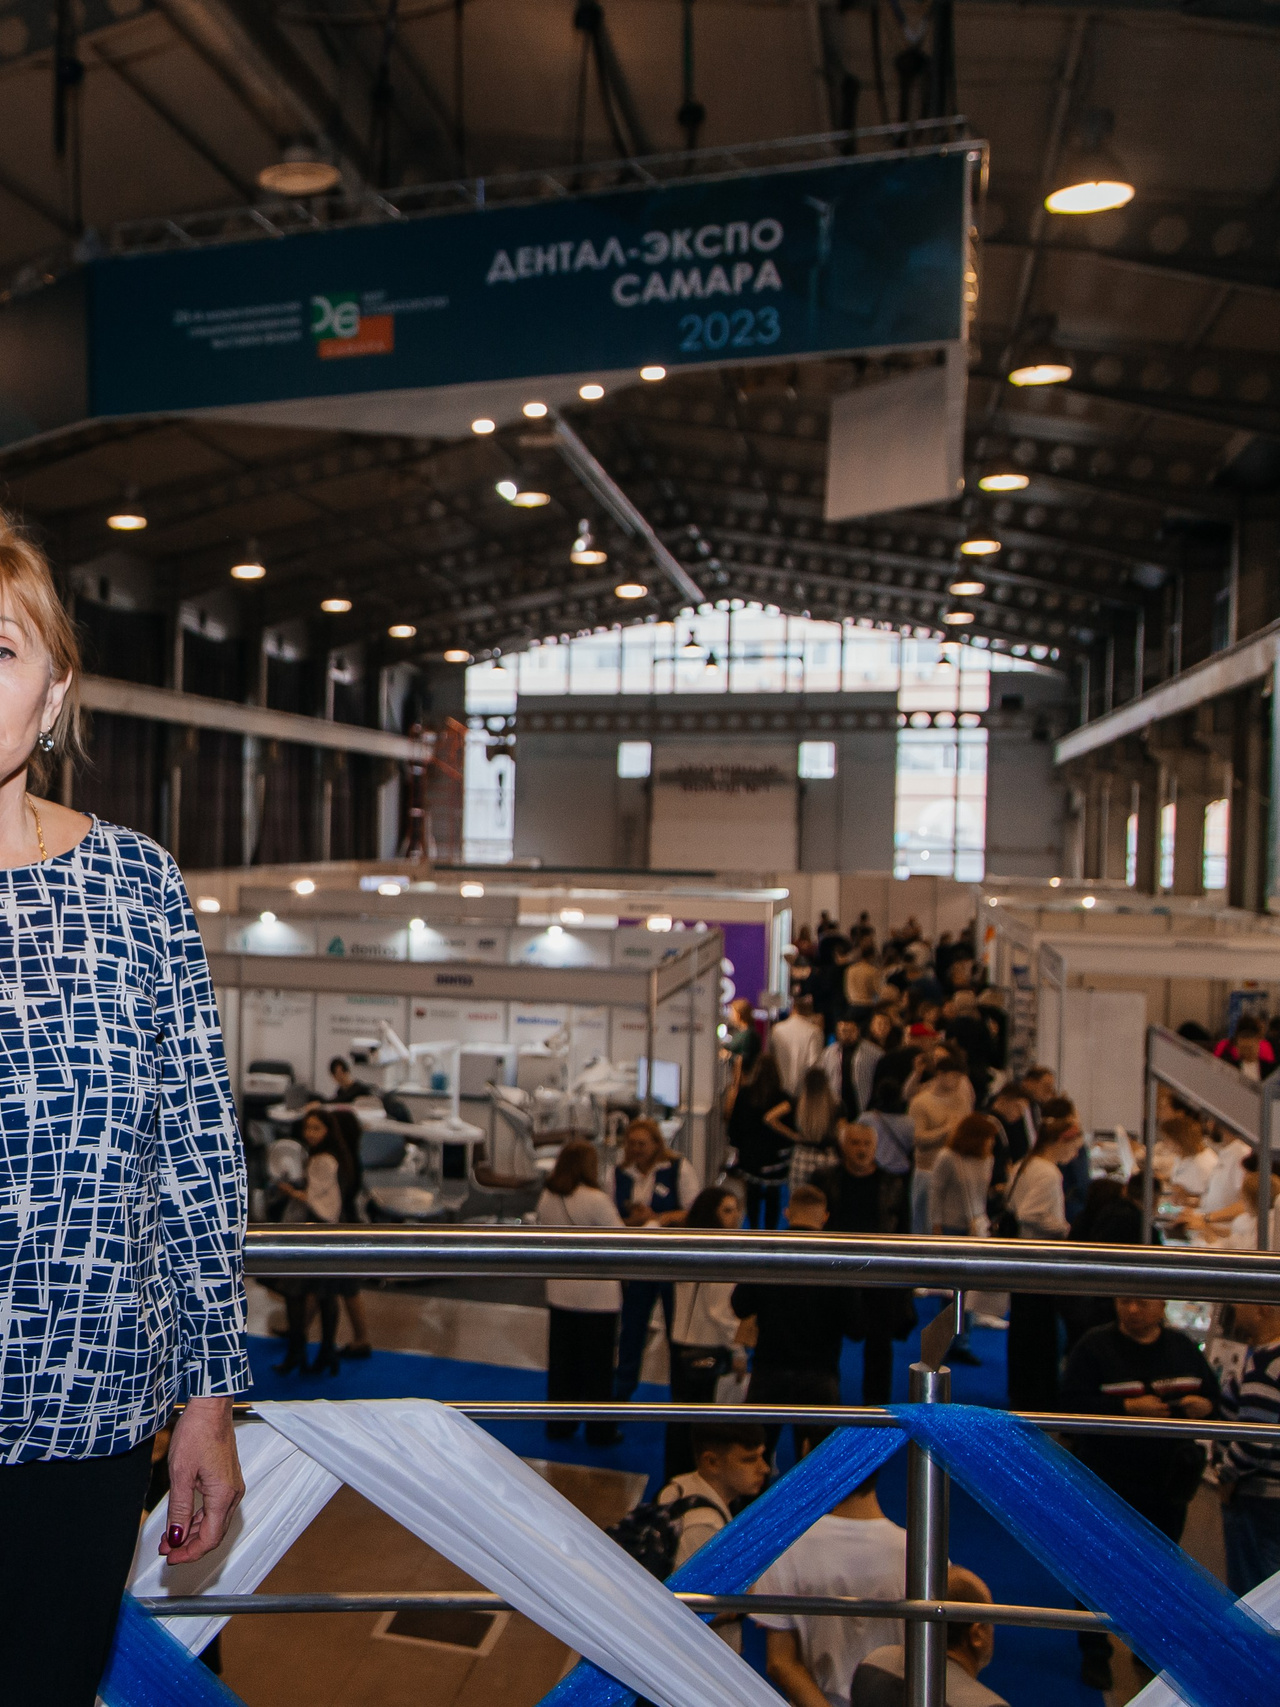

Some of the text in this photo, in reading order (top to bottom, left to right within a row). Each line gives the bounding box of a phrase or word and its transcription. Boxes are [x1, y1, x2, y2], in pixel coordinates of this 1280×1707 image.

[486, 217, 784, 285] ДЕНТАЛ-ЭКСПО
[612, 258, 783, 308] САМАРА
[678, 305, 782, 352] 2023
